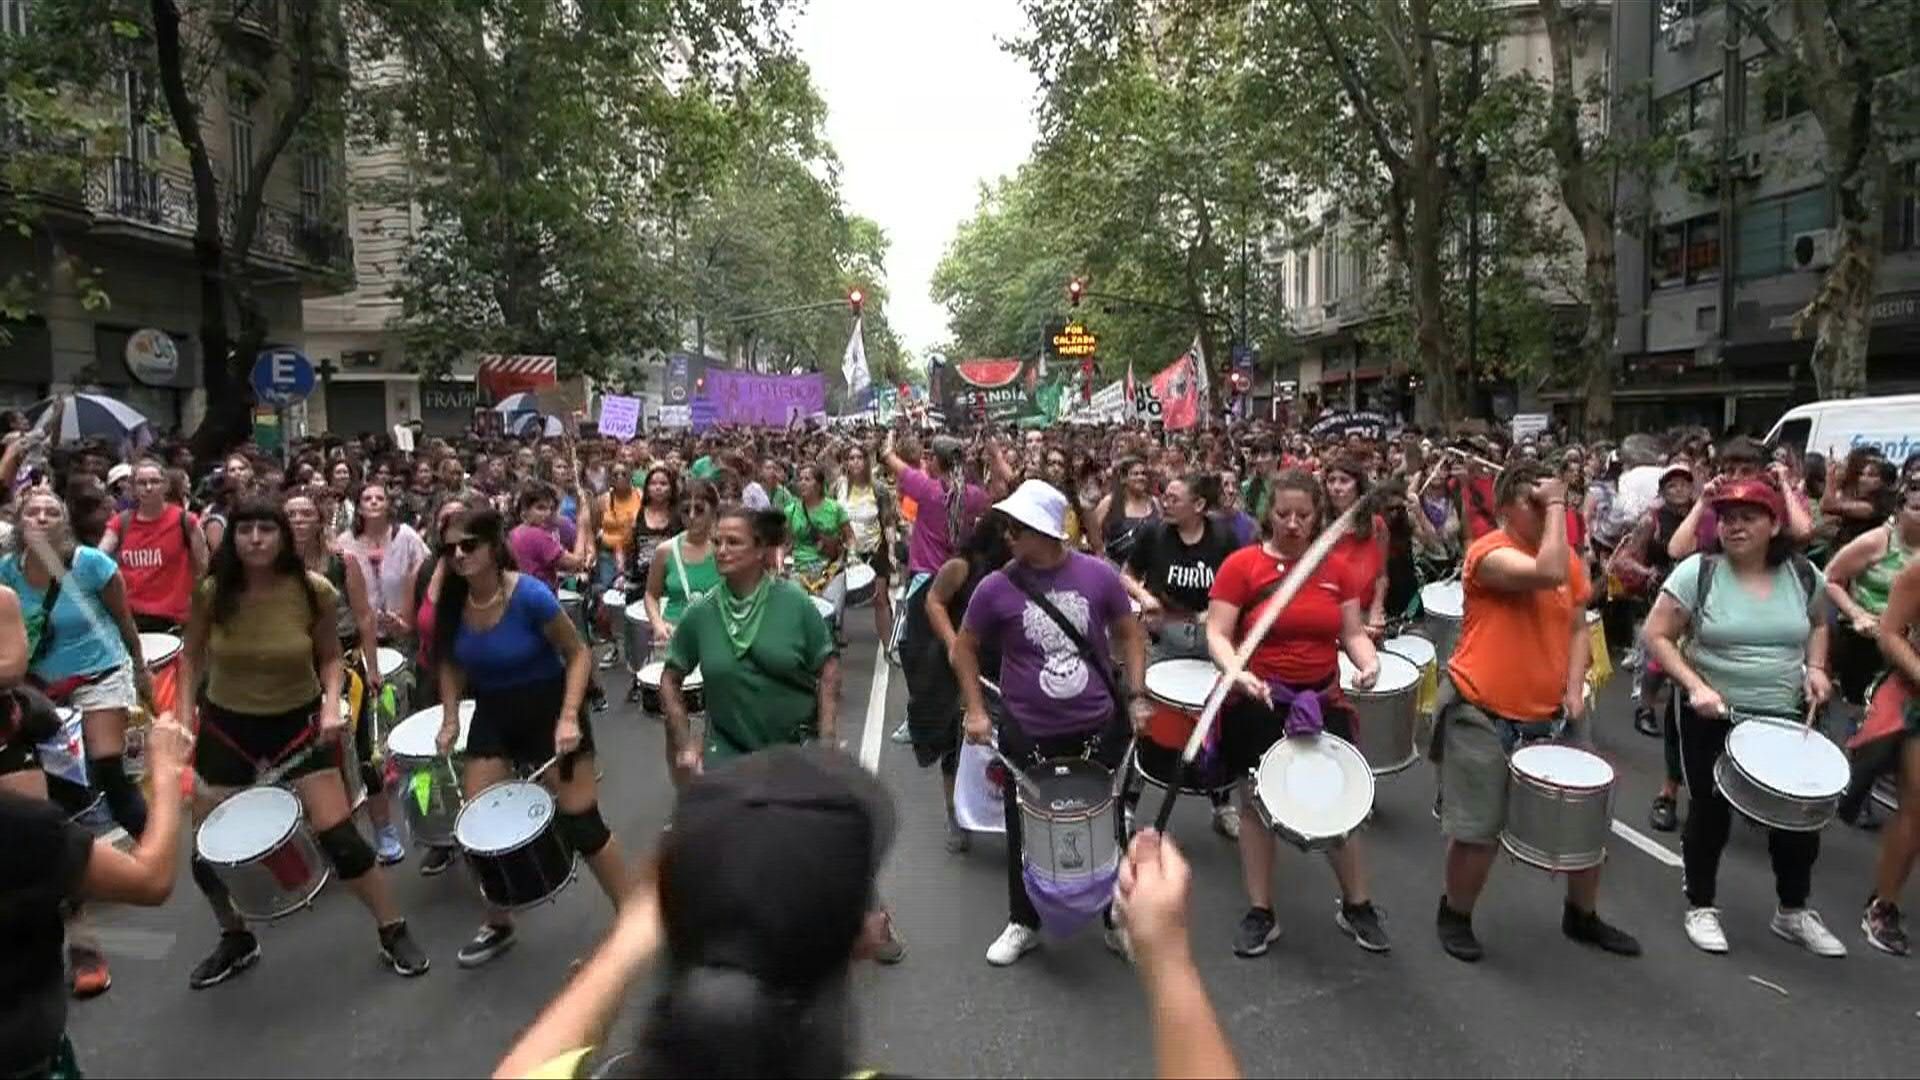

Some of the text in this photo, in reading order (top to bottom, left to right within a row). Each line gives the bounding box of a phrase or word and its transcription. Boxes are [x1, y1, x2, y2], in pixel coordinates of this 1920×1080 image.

[1053, 335, 1095, 345] CALZADA
[272, 354, 296, 383] E
[604, 418, 634, 434] VIVAS
[121, 548, 162, 567] FURIA
